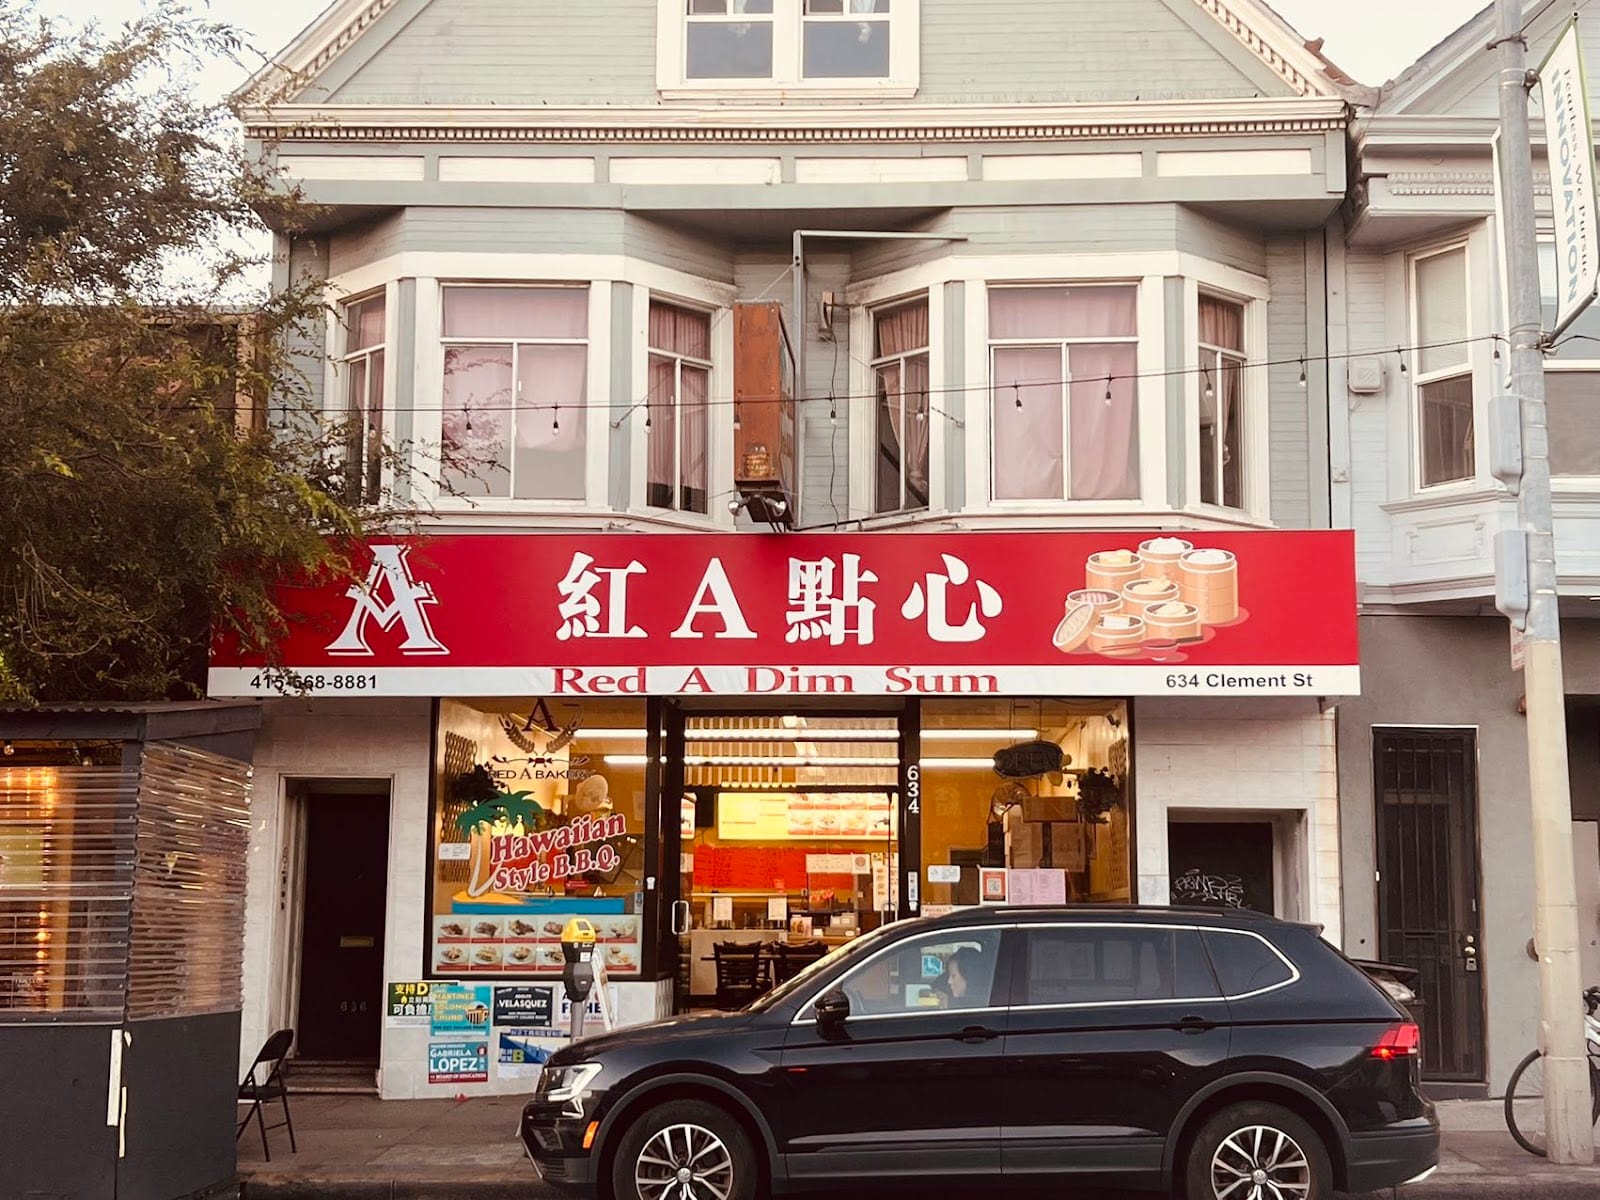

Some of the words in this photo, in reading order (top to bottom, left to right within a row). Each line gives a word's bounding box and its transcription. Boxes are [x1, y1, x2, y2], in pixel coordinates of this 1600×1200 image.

[1551, 69, 1578, 304] INNOVATION
[1574, 163, 1583, 199] We
[1578, 205, 1588, 277] Pursue
[551, 667, 648, 693] Red
[675, 667, 713, 692] A
[744, 666, 856, 693] Dim
[885, 666, 1000, 693] Sum
[1166, 674, 1199, 688] 634
[1206, 673, 1286, 687] Clement
[1293, 673, 1313, 687] St
[521, 696, 563, 731] A
[488, 769, 517, 779] RED
[519, 768, 532, 780] A
[907, 766, 919, 813] 634
[490, 813, 626, 865] Hawaiian
[493, 861, 550, 891] Style
[553, 844, 620, 878] B.B.Q.
[499, 999, 547, 1009] VELASQUEZ
[430, 1048, 471, 1057] GABRIELA
